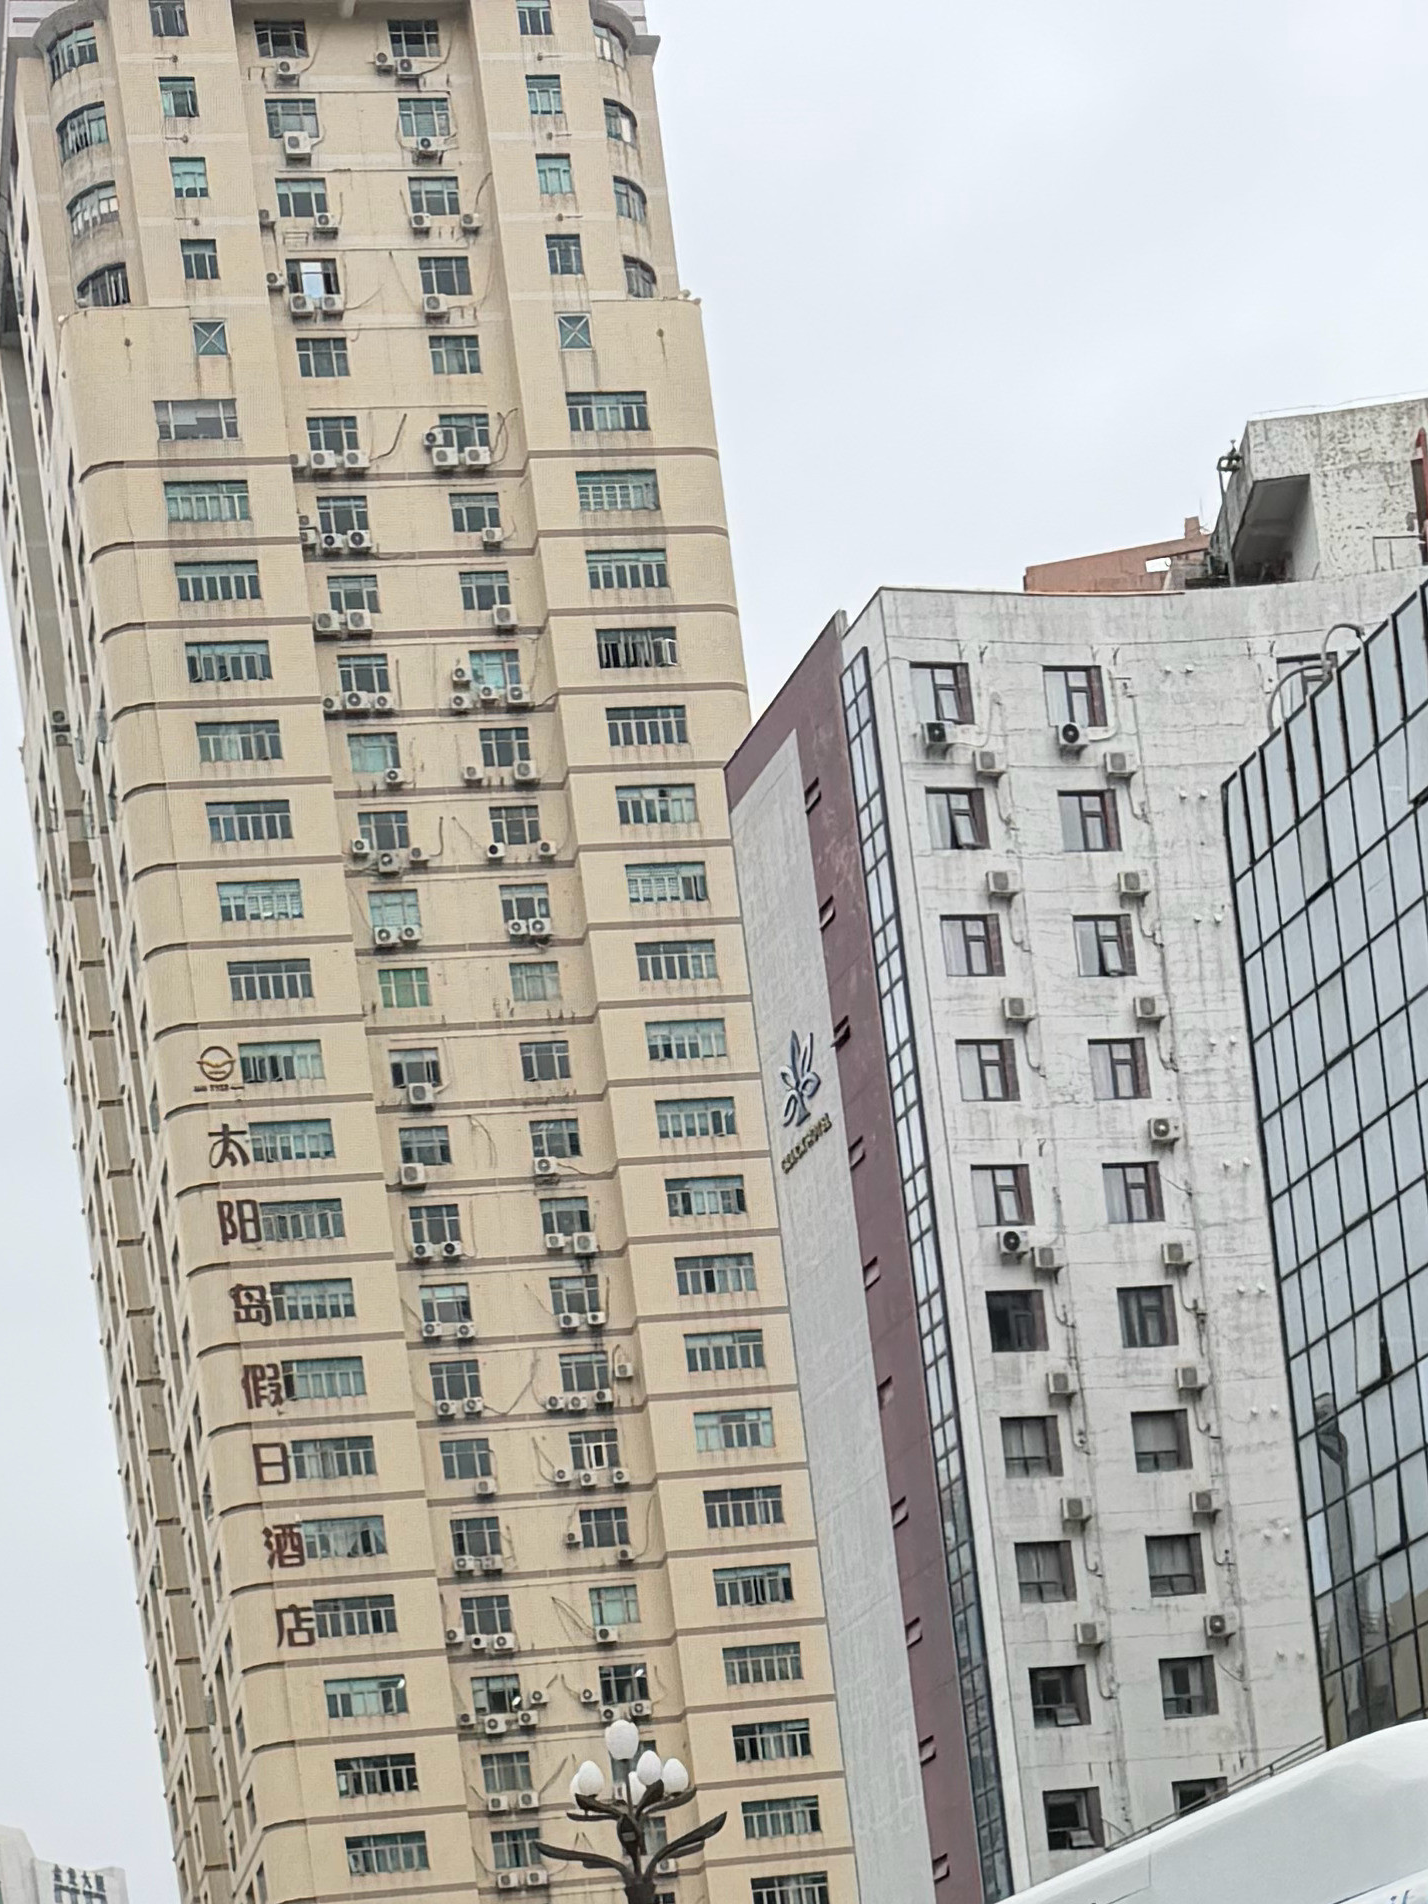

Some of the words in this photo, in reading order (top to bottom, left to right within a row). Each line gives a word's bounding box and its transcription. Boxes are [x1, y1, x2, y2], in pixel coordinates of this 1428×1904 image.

[208, 1123, 318, 1649] 太阳岛假日酒店
